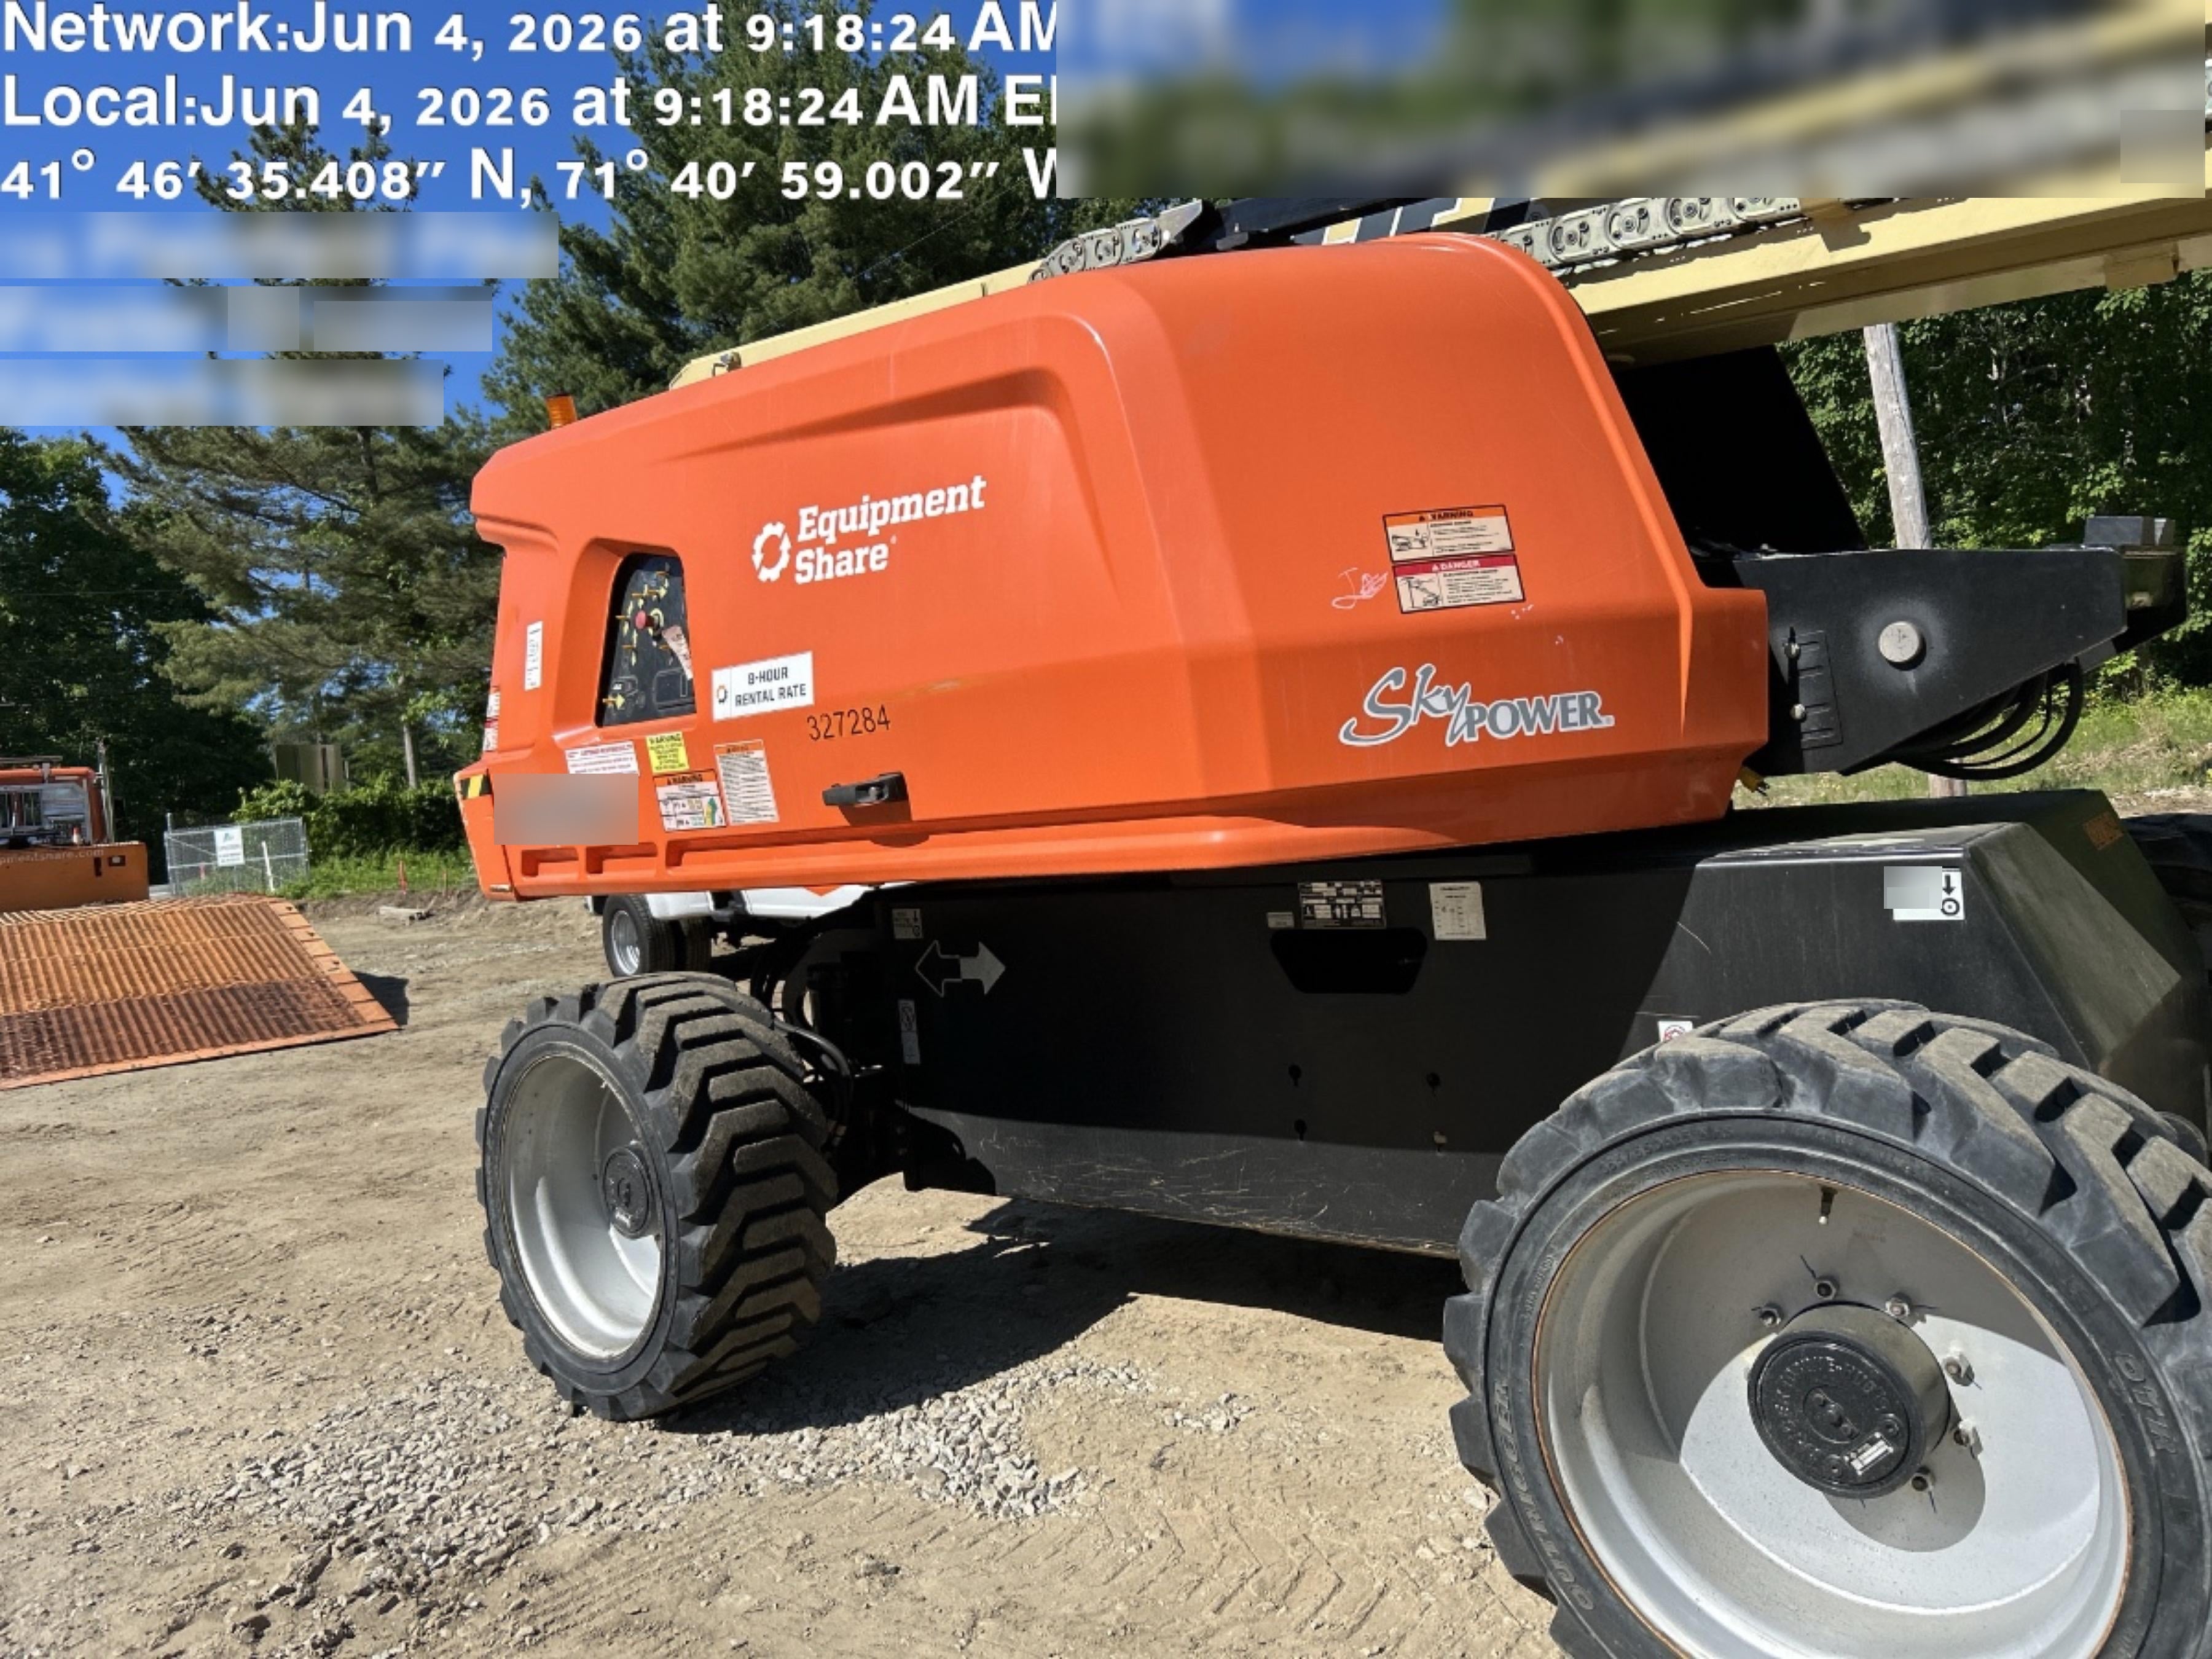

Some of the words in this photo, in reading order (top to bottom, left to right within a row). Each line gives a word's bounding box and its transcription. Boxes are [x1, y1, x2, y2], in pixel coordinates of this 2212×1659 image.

[797, 474, 987, 545] Equipment
[794, 543, 889, 585] Share
[1440, 560, 1480, 571] DANGER
[748, 666, 789, 685] 8-HOUR
[735, 690, 775, 707] RENTAL
[778, 683, 807, 699] RATE
[806, 704, 891, 742] 327284
